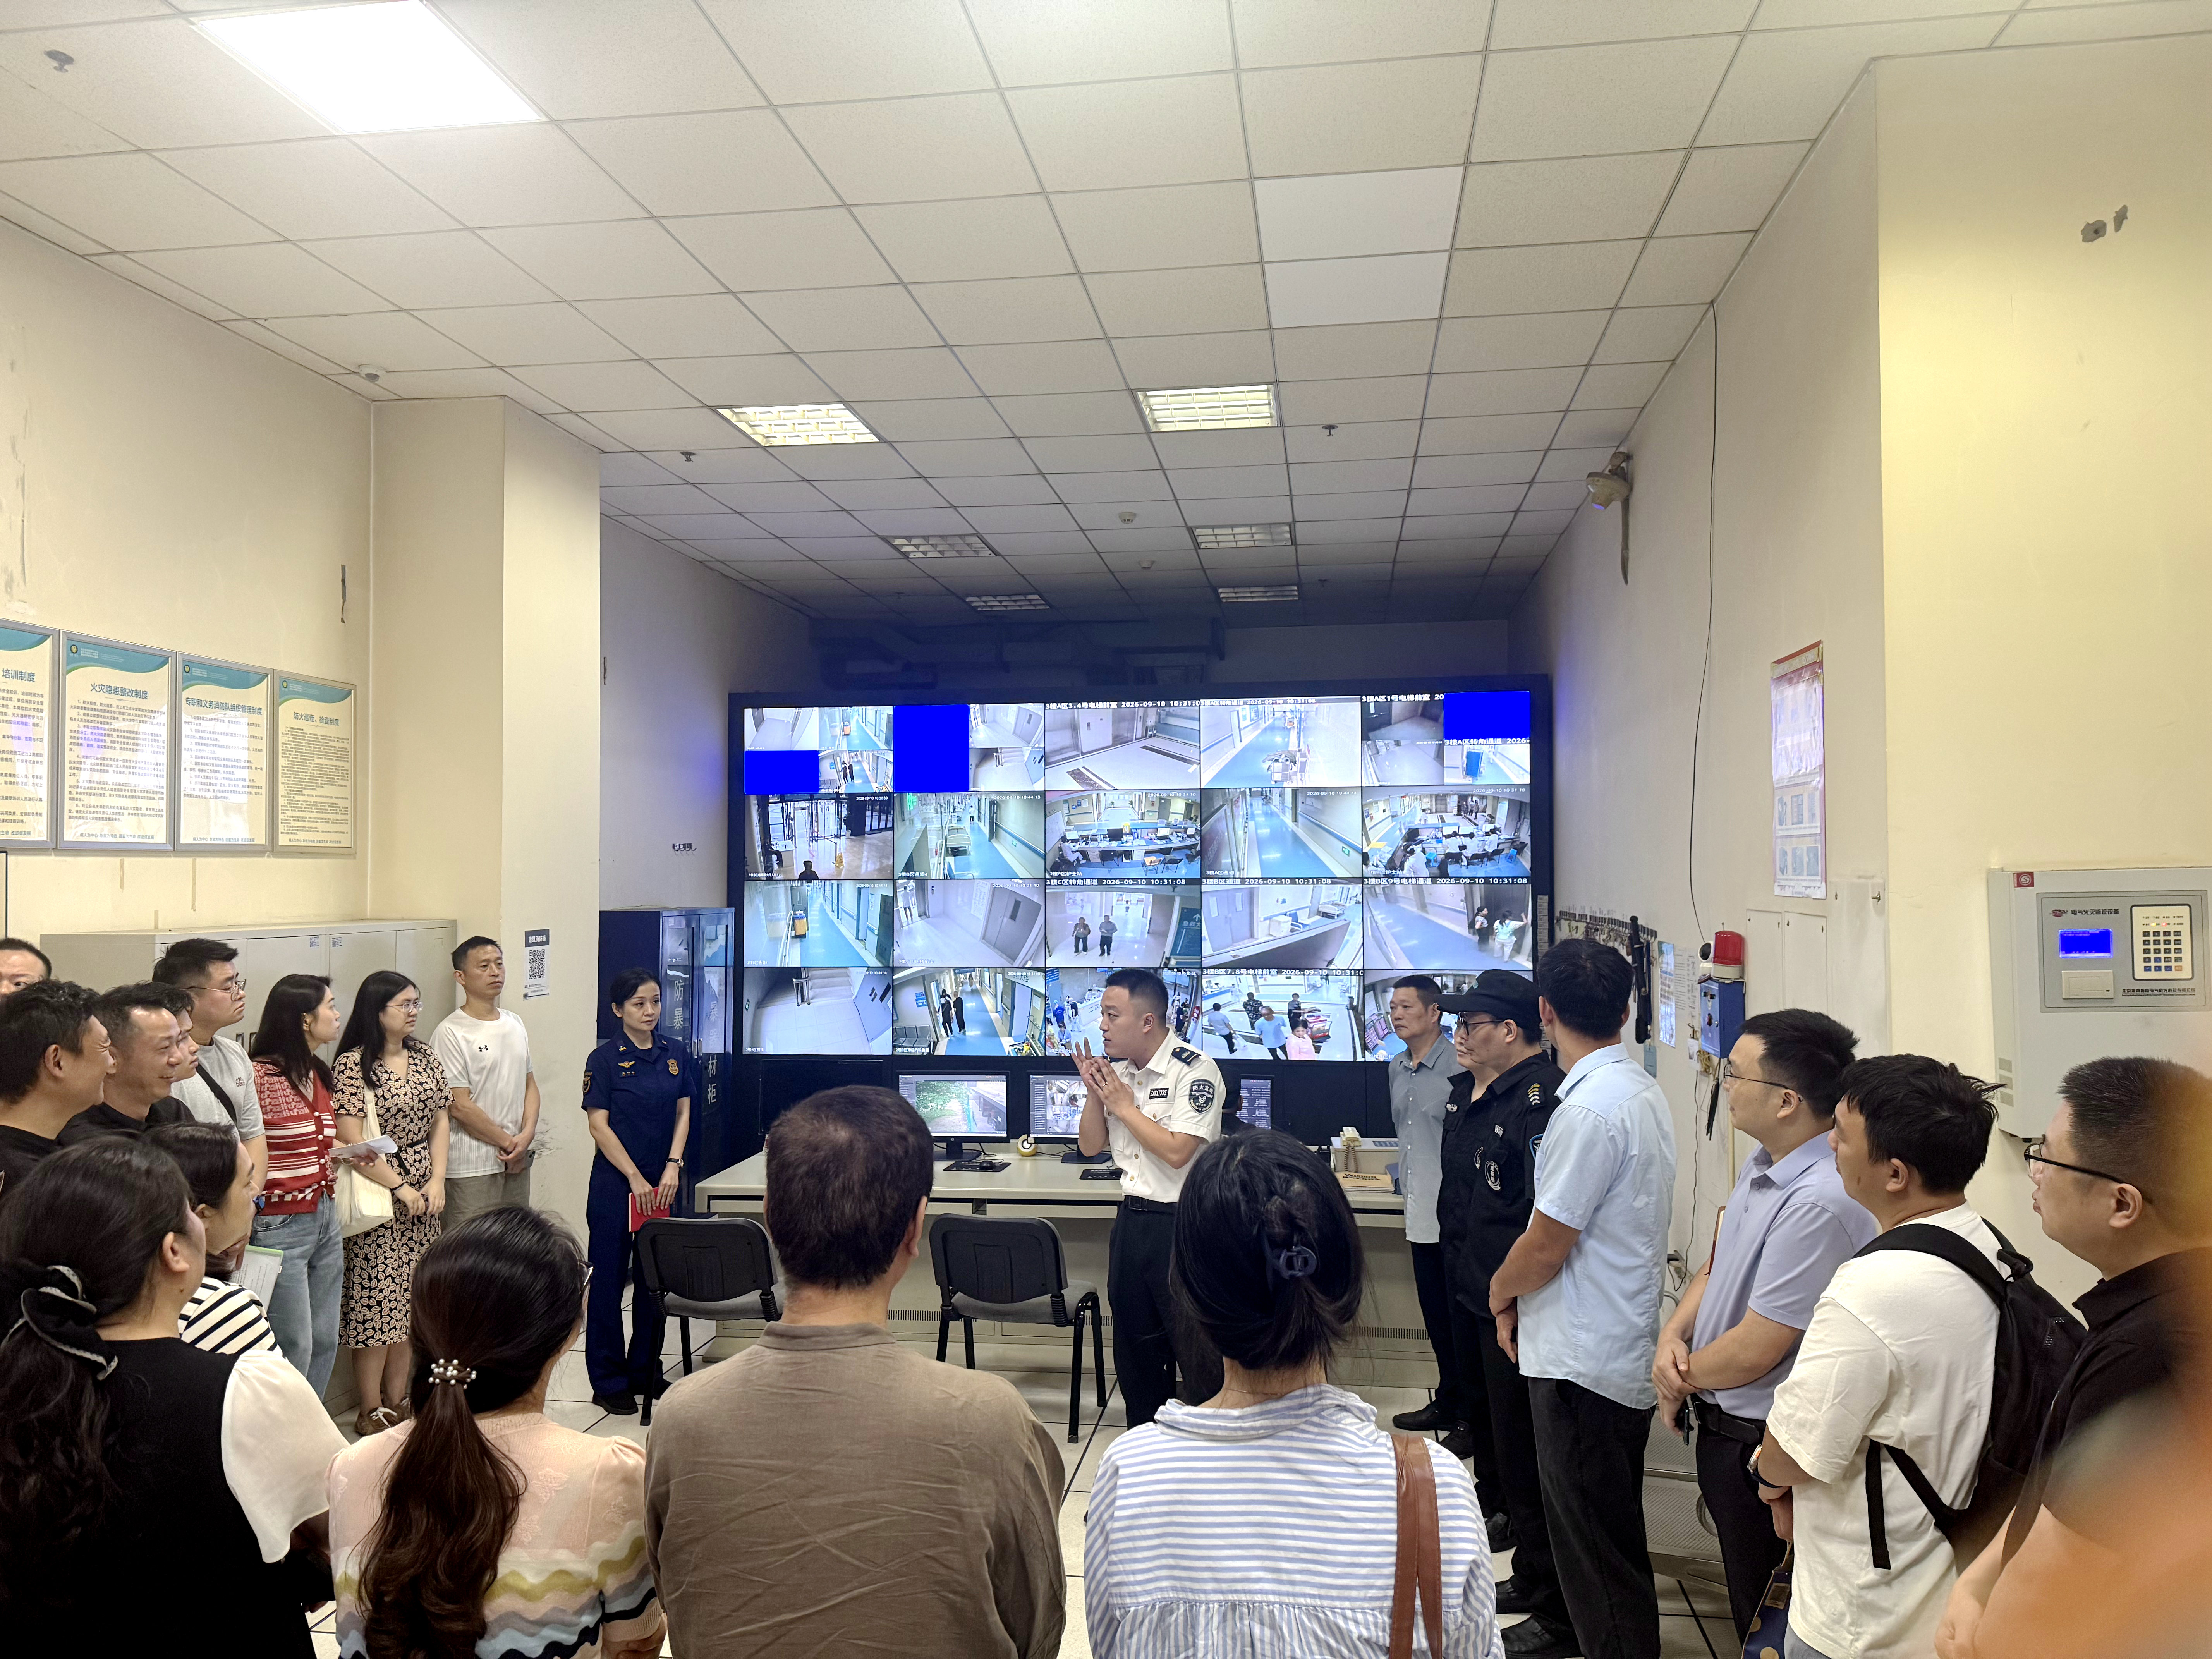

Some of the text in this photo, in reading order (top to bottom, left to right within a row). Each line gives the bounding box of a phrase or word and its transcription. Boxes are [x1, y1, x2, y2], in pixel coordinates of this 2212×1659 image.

[2, 668, 35, 682] 培训制度
[91, 683, 149, 699] 火灾隐患整改制度
[185, 697, 262, 715] 专职和义务消防队组织管理制度
[293, 711, 339, 726] 防火巡查、检查制度
